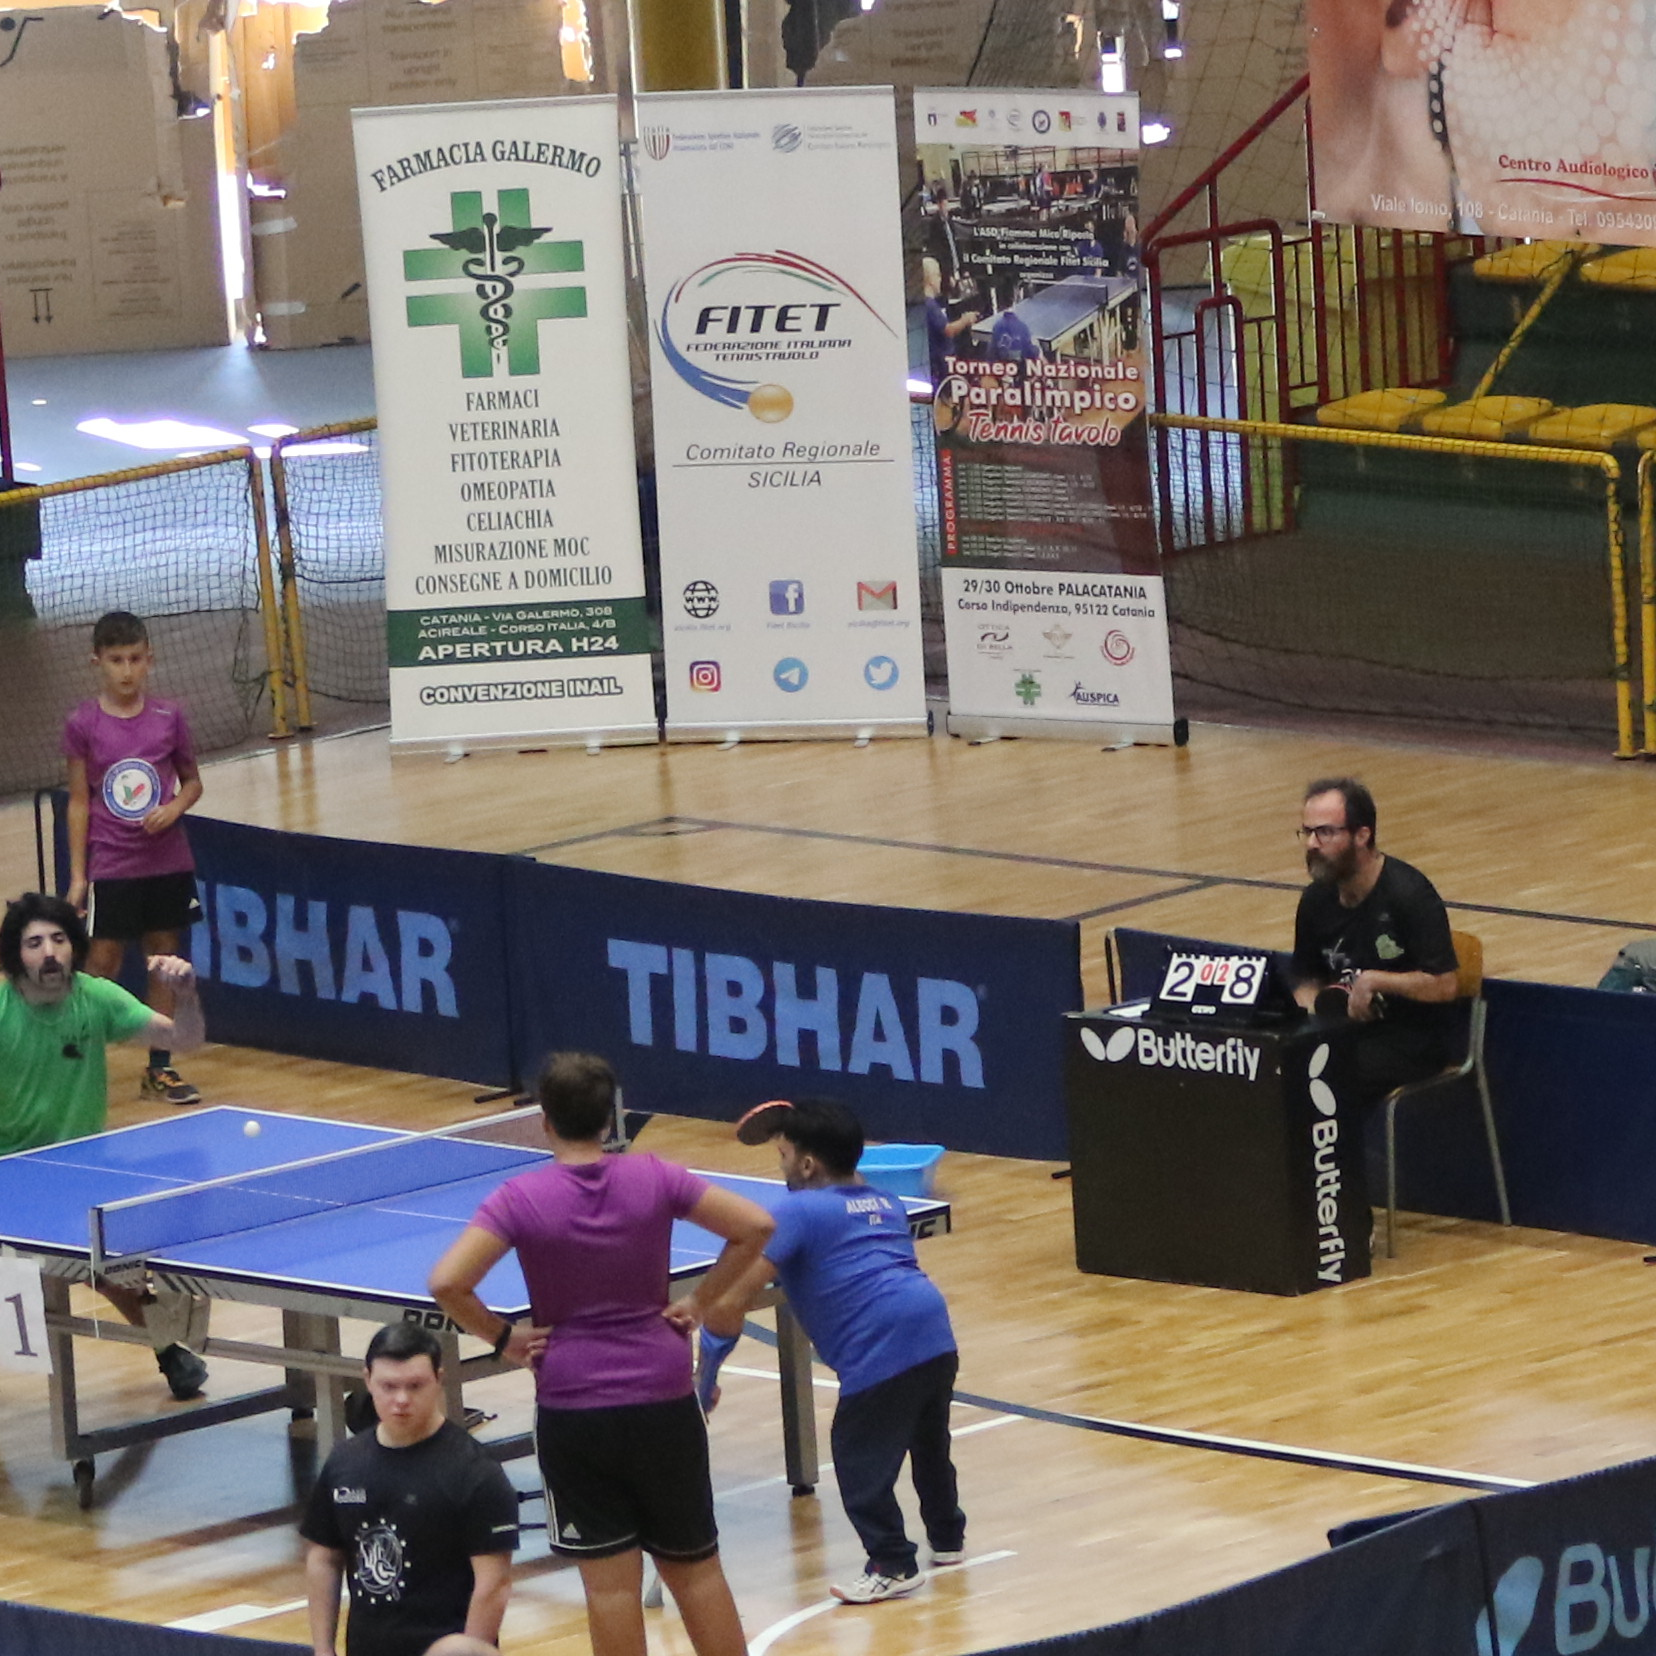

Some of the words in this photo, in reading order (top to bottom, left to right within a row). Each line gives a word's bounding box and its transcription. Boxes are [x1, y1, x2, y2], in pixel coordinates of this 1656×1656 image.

[371, 141, 488, 192] FARMACIA
[492, 139, 602, 179] GALERMO
[1499, 154, 1551, 172] Centro
[1555, 159, 1649, 180] Audiologico
[1371, 194, 1405, 212] Viale
[1458, 200, 1483, 218] 108
[1498, 204, 1554, 225] Catania
[696, 303, 841, 335] FITET
[686, 340, 781, 352] FEDERAZIONE
[786, 338, 852, 350] ITALIANA
[714, 351, 819, 363] TENNISTAVOLO
[945, 356, 1018, 377] Torneo
[1027, 358, 1139, 381] Nazionale
[465, 389, 540, 412] FARMACI
[951, 381, 1137, 412] Paralimpico
[449, 419, 560, 442] VETERINARIA
[967, 410, 1043, 442] Tennis
[1048, 415, 1122, 446] tavolo
[451, 448, 561, 472] FITOTERAPIA
[686, 443, 775, 461] Comitato
[782, 440, 880, 461] Regionale
[461, 479, 556, 502] OMEOPATIA
[748, 470, 822, 488] SICILIA
[945, 455, 957, 551] PROGRAMMA
[467, 509, 554, 532] CELIACHIA
[434, 540, 548, 564] MISURAZIONE
[554, 537, 590, 557] MOC
[416, 571, 502, 595] CONSEGNE
[508, 571, 519, 589] A
[525, 566, 612, 589] DOMICILIO
[963, 580, 1000, 594] 29/30
[1005, 581, 1053, 597] Ottobre
[1058, 583, 1147, 600] PALACATANIA
[420, 613, 481, 626] CATANIA
[958, 598, 988, 611] Corso
[991, 600, 1072, 616] Indipendenza,
[1075, 603, 1108, 616] 95122
[1113, 605, 1155, 618] Catania
[417, 625, 487, 639] ACIREALE
[417, 638, 564, 661] APERTURA
[571, 635, 619, 652] H24
[419, 680, 564, 705] CONVENZIONE
[567, 677, 623, 697] INAIL
[1166, 961, 1195, 997] 2
[1200, 963, 1214, 981] 0
[1217, 964, 1230, 982] 2
[1229, 963, 1256, 998] 8
[606, 939, 985, 1089] TIBHAR
[1137, 1028, 1260, 1082] Butterfly
[1312, 1118, 1345, 1283] Butterfly
[5, 1293, 37, 1357] 1
